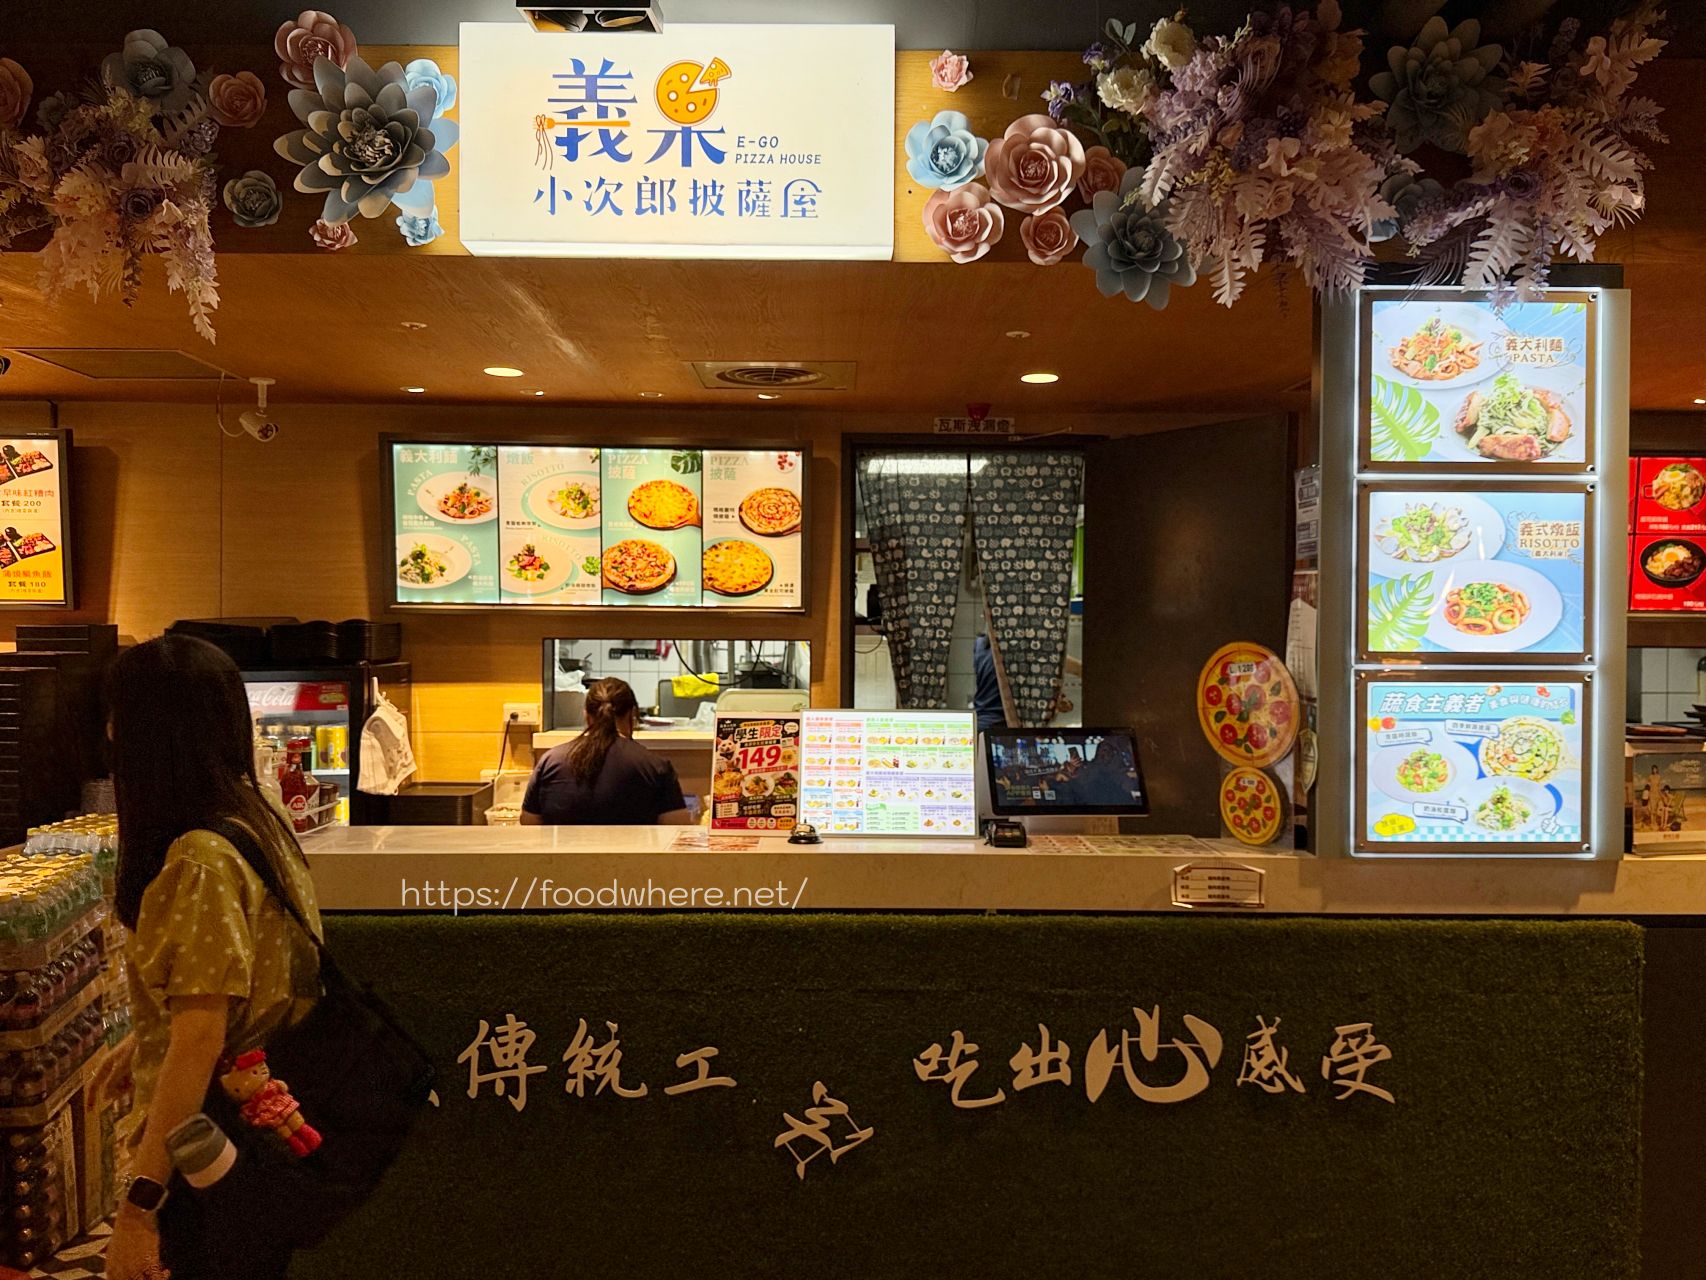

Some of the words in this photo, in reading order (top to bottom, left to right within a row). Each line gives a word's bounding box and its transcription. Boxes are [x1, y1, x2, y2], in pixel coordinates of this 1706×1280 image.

[736, 136, 780, 149] E-GO
[735, 153, 775, 165] PIZZA
[780, 154, 822, 165] HOUSE
[532, 174, 823, 219] 小次郎披薩屋
[1513, 353, 1554, 363] PASTA
[607, 453, 649, 465] PIZZA
[710, 455, 749, 466] PIZZA
[407, 470, 433, 496] PASTA
[520, 463, 564, 488] RISOTTO
[1519, 539, 1580, 548] RISOTTO
[1379, 691, 1486, 713] 蔬食主義者
[738, 745, 781, 769] 149
[912, 1003, 1396, 1108] 吃出心感受
